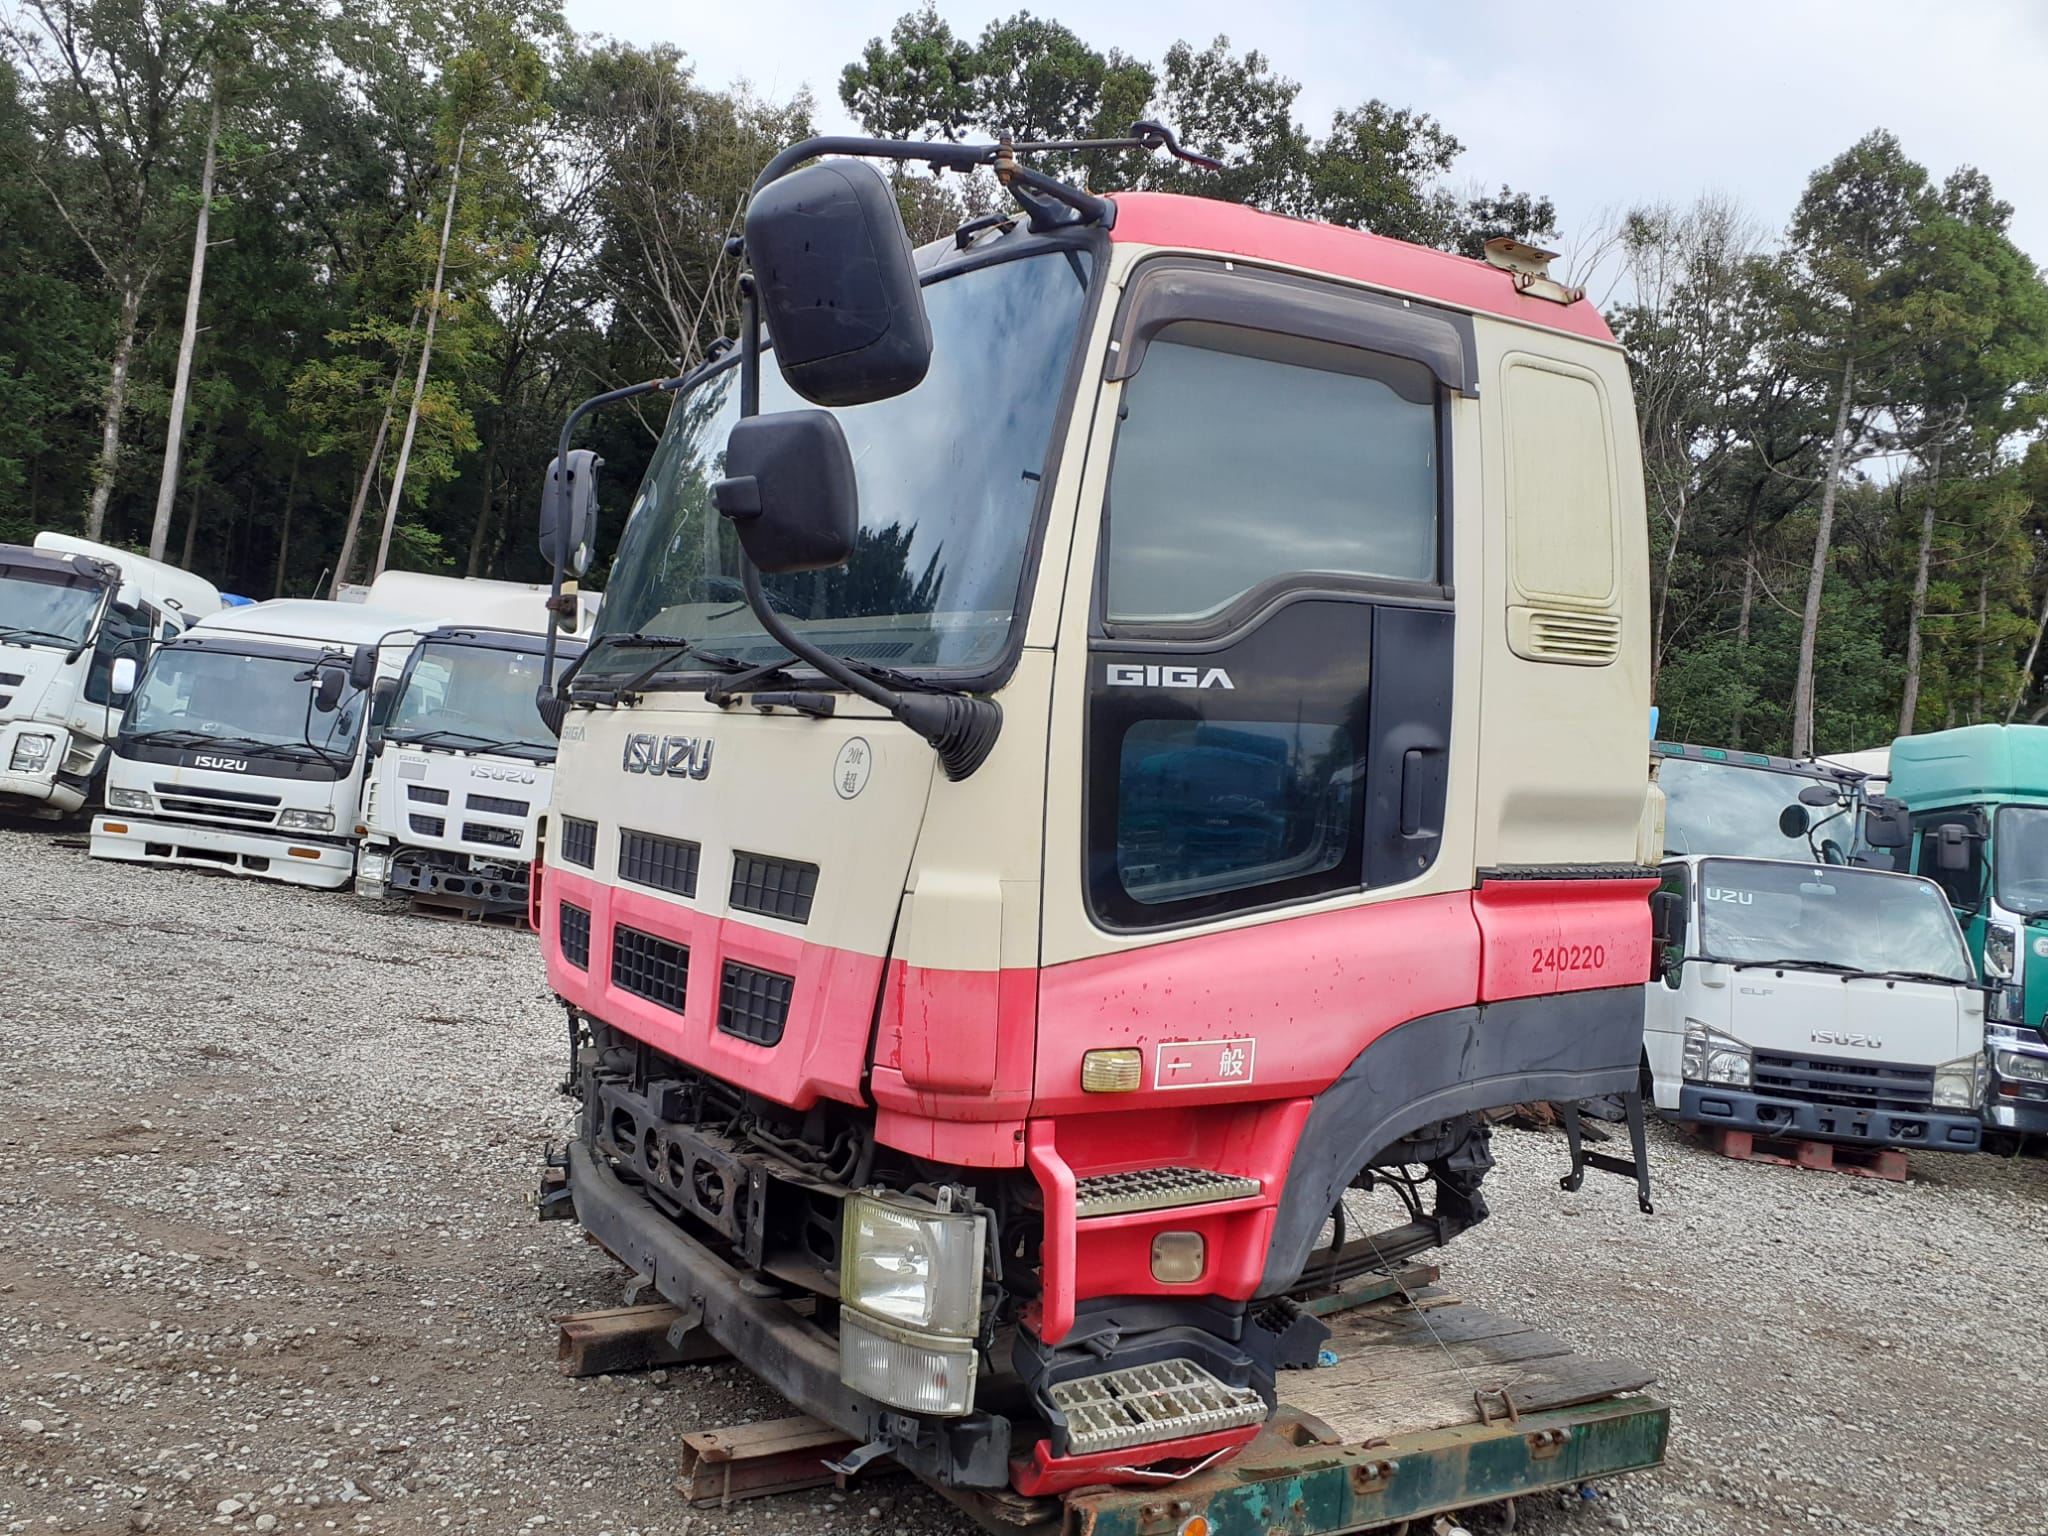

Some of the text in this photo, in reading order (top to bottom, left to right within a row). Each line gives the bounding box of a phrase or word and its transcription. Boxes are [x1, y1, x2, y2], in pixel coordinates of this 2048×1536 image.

[1107, 664, 1235, 689] GIGA
[562, 726, 585, 741] GIGA
[195, 756, 248, 771] ISUZU
[623, 732, 714, 781] ISUZU
[470, 764, 536, 785] ISUZU
[1532, 945, 1605, 973] 240220
[1740, 987, 1774, 996] ELF
[1811, 1029, 1883, 1049] ISUZU
